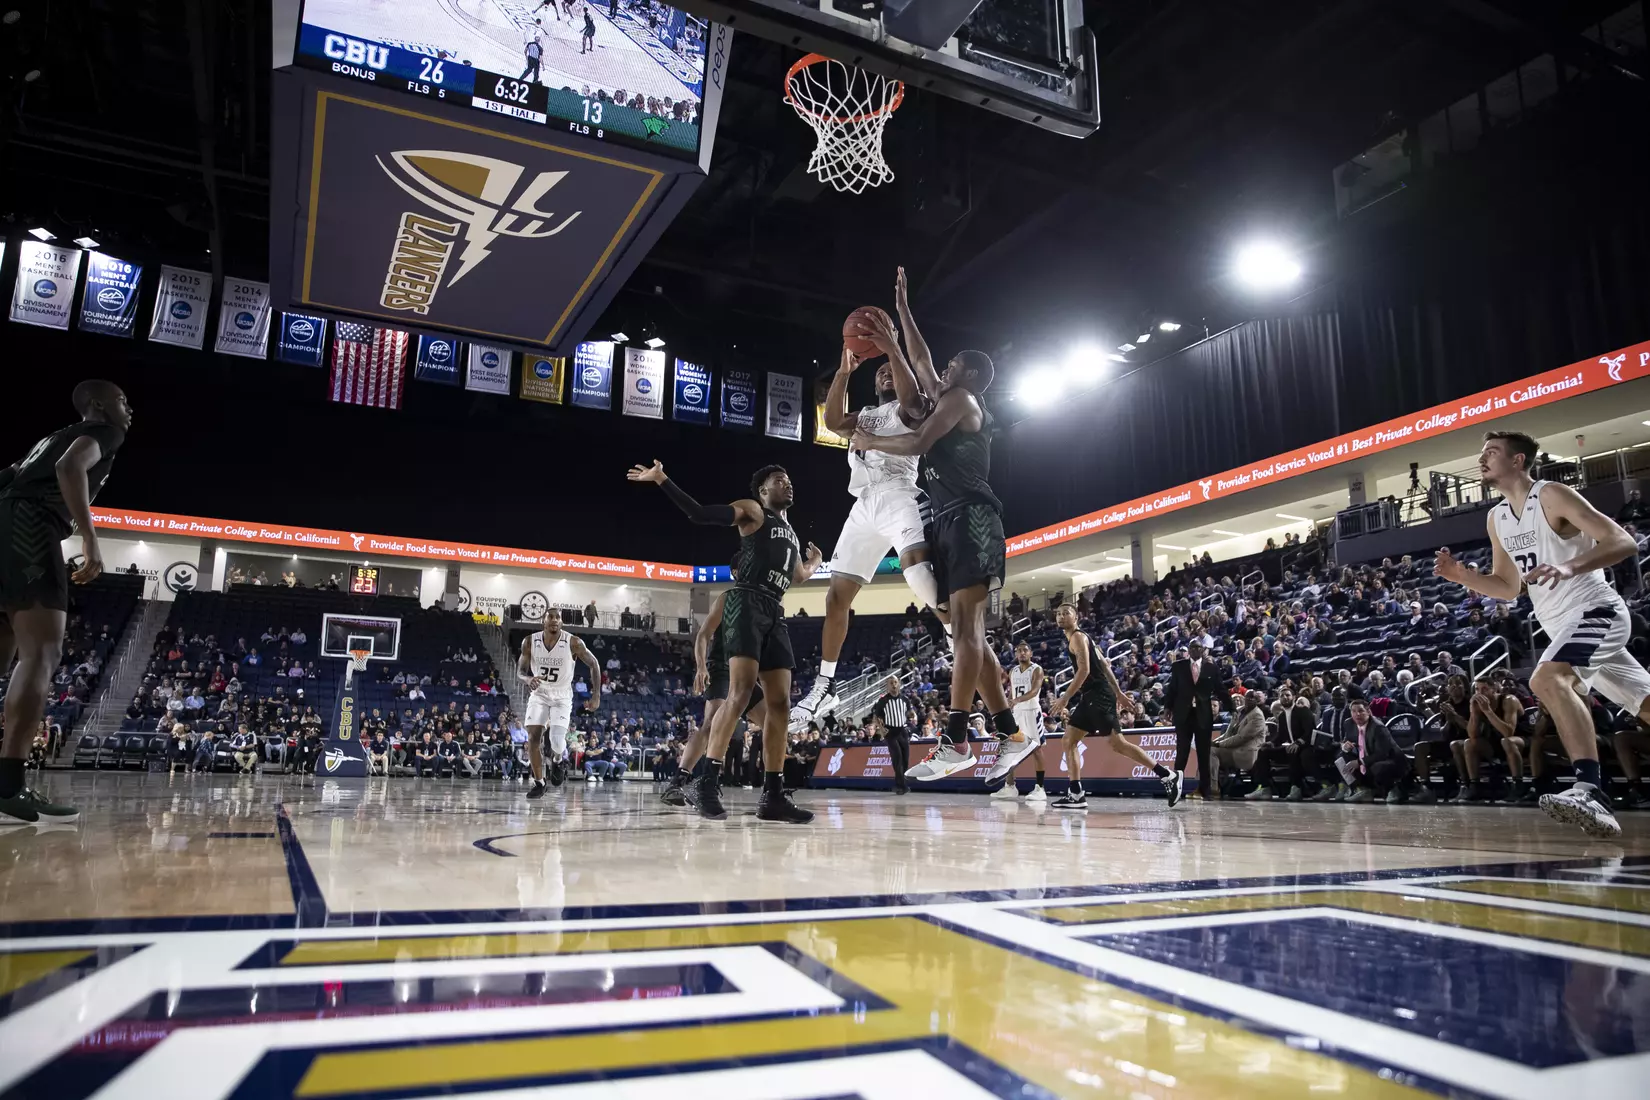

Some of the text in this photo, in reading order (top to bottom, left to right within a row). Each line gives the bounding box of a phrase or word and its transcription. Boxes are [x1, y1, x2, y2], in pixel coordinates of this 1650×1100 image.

[324, 34, 390, 70] CBU
[332, 62, 376, 81] BONUS
[419, 58, 444, 84] 26
[408, 81, 446, 98] FLS 5
[494, 78, 530, 104] 6:32
[485, 101, 537, 121] 1ST HALF
[582, 100, 603, 124] 13
[570, 122, 604, 138] FLS 8
[35, 251, 67, 263] 2016
[35, 261, 62, 271] MEN'S
[380, 212, 461, 315] LANCERS
[21, 267, 74, 280] BASKETBALL
[100, 271, 127, 281] MEN'S
[88, 276, 137, 289] BASKETBALL
[171, 274, 201, 286] 2015
[172, 284, 196, 293] MEN'S
[234, 285, 262, 297] 2014
[160, 290, 207, 302] BASKETBALL
[235, 295, 258, 304] MEN'S
[23, 299, 56, 310] DIVISION
[223, 301, 270, 313] BASKETBALL
[15, 304, 68, 318] TOURNAMENT
[157, 320, 191, 330] DIVISION
[159, 328, 185, 337] SWEET
[226, 331, 255, 340] DIVISION
[219, 336, 266, 347] TOURNAMENT
[279, 342, 321, 353] CHAMPIONS
[418, 361, 458, 373] CHAMPIONS
[683, 362, 705, 372] 2017
[471, 369, 508, 379] WEST REGION
[471, 375, 506, 385] CHAMPIONS
[680, 369, 707, 379] WOMEN'S
[730, 370, 751, 380] 2017
[775, 379, 795, 388] 2017
[572, 387, 609, 398] CHAMPIONS
[675, 404, 709, 414] CHAMPIONS
[1103, 511, 1126, 524] College
[1127, 504, 1144, 518] Food
[1145, 502, 1153, 512] in
[1153, 491, 1191, 509] California!
[1217, 474, 1250, 491] Provider
[1252, 465, 1273, 480] Food
[1275, 458, 1306, 474] Service
[1307, 447, 1334, 463] Voted
[1336, 442, 1349, 455] #1
[1352, 435, 1373, 452] Best
[1375, 426, 1413, 445] Private
[1415, 411, 1458, 432] College
[1460, 399, 1492, 419] Food
[1494, 397, 1507, 409] in
[1510, 372, 1584, 404] California!
[90, 512, 122, 524] Service
[124, 515, 151, 527] Voted
[153, 519, 165, 528] #1
[168, 520, 188, 530] Best
[190, 523, 222, 534] Private
[224, 526, 258, 538] College
[259, 529, 282, 539] Food
[284, 531, 293, 541] in
[294, 533, 340, 545] California!
[370, 540, 404, 552] Provider
[406, 543, 427, 554] Food
[428, 546, 456, 557] Service
[457, 548, 479, 558] Voted
[481, 550, 491, 560] #1
[493, 552, 509, 561] Best
[510, 553, 538, 564] Private
[539, 556, 567, 567] College
[568, 559, 587, 569] Food
[588, 561, 596, 569] in
[597, 562, 635, 573] California!
[659, 568, 688, 578] Provider
[783, 548, 792, 572] 1
[115, 566, 159, 576] BIBALLY
[358, 568, 377, 578] 6:32
[354, 577, 373, 592] 23
[540, 667, 560, 682] 35
[1015, 686, 1025, 695] 15
[339, 697, 353, 740] CBU
[1144, 750, 1177, 761] EDICA
